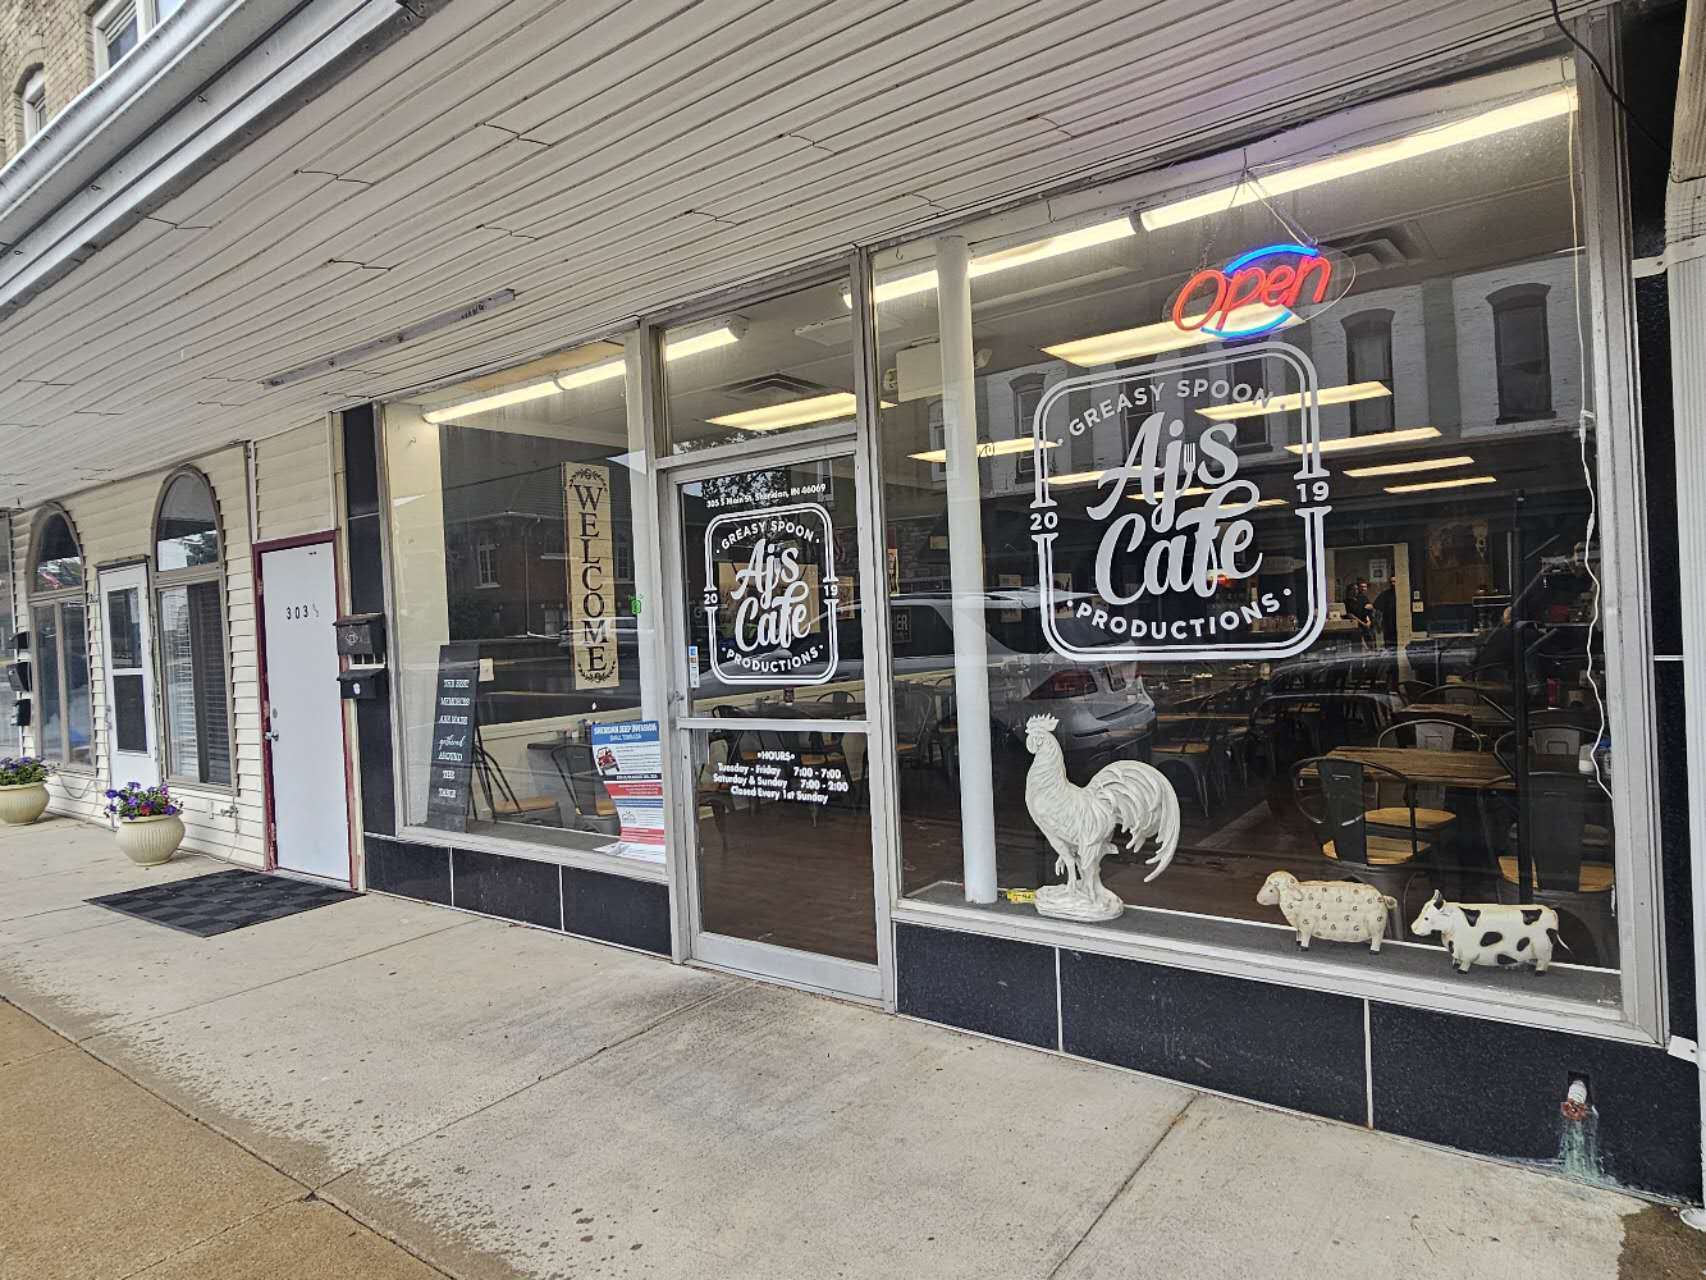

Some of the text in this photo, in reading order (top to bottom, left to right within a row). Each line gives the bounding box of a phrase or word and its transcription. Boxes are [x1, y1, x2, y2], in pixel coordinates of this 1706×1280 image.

[1173, 255, 1332, 331] Open
[1069, 379, 1274, 436] GREASY SPOON
[726, 496, 744, 505] Main
[790, 487, 800, 497] IN
[801, 483, 826, 495] 46069
[1297, 481, 1329, 503] 19
[1030, 511, 1058, 531] 20
[721, 520, 814, 550] GREASY SPOON
[1094, 479, 1263, 605] Cafe
[573, 484, 608, 672] WELCOME
[703, 593, 718, 605] 20
[824, 584, 838, 597] 19
[286, 604, 309, 620] 303
[735, 580, 811, 652] Cafe
[1076, 593, 1281, 640] PRODUCTIONS
[726, 646, 819, 673] PRODUCTIONS
[761, 751, 791, 761] HOURS
[717, 762, 749, 775] Tuesday
[755, 765, 781, 776] Friday
[793, 766, 813, 778] 7:00
[821, 768, 841, 779] 7:00
[713, 773, 747, 786] Saturday
[757, 777, 788, 788] Sunday
[800, 779, 820, 791] 7:00
[828, 780, 849, 792] 2:00
[730, 786, 829, 805] Closed Every 1st Sunday
